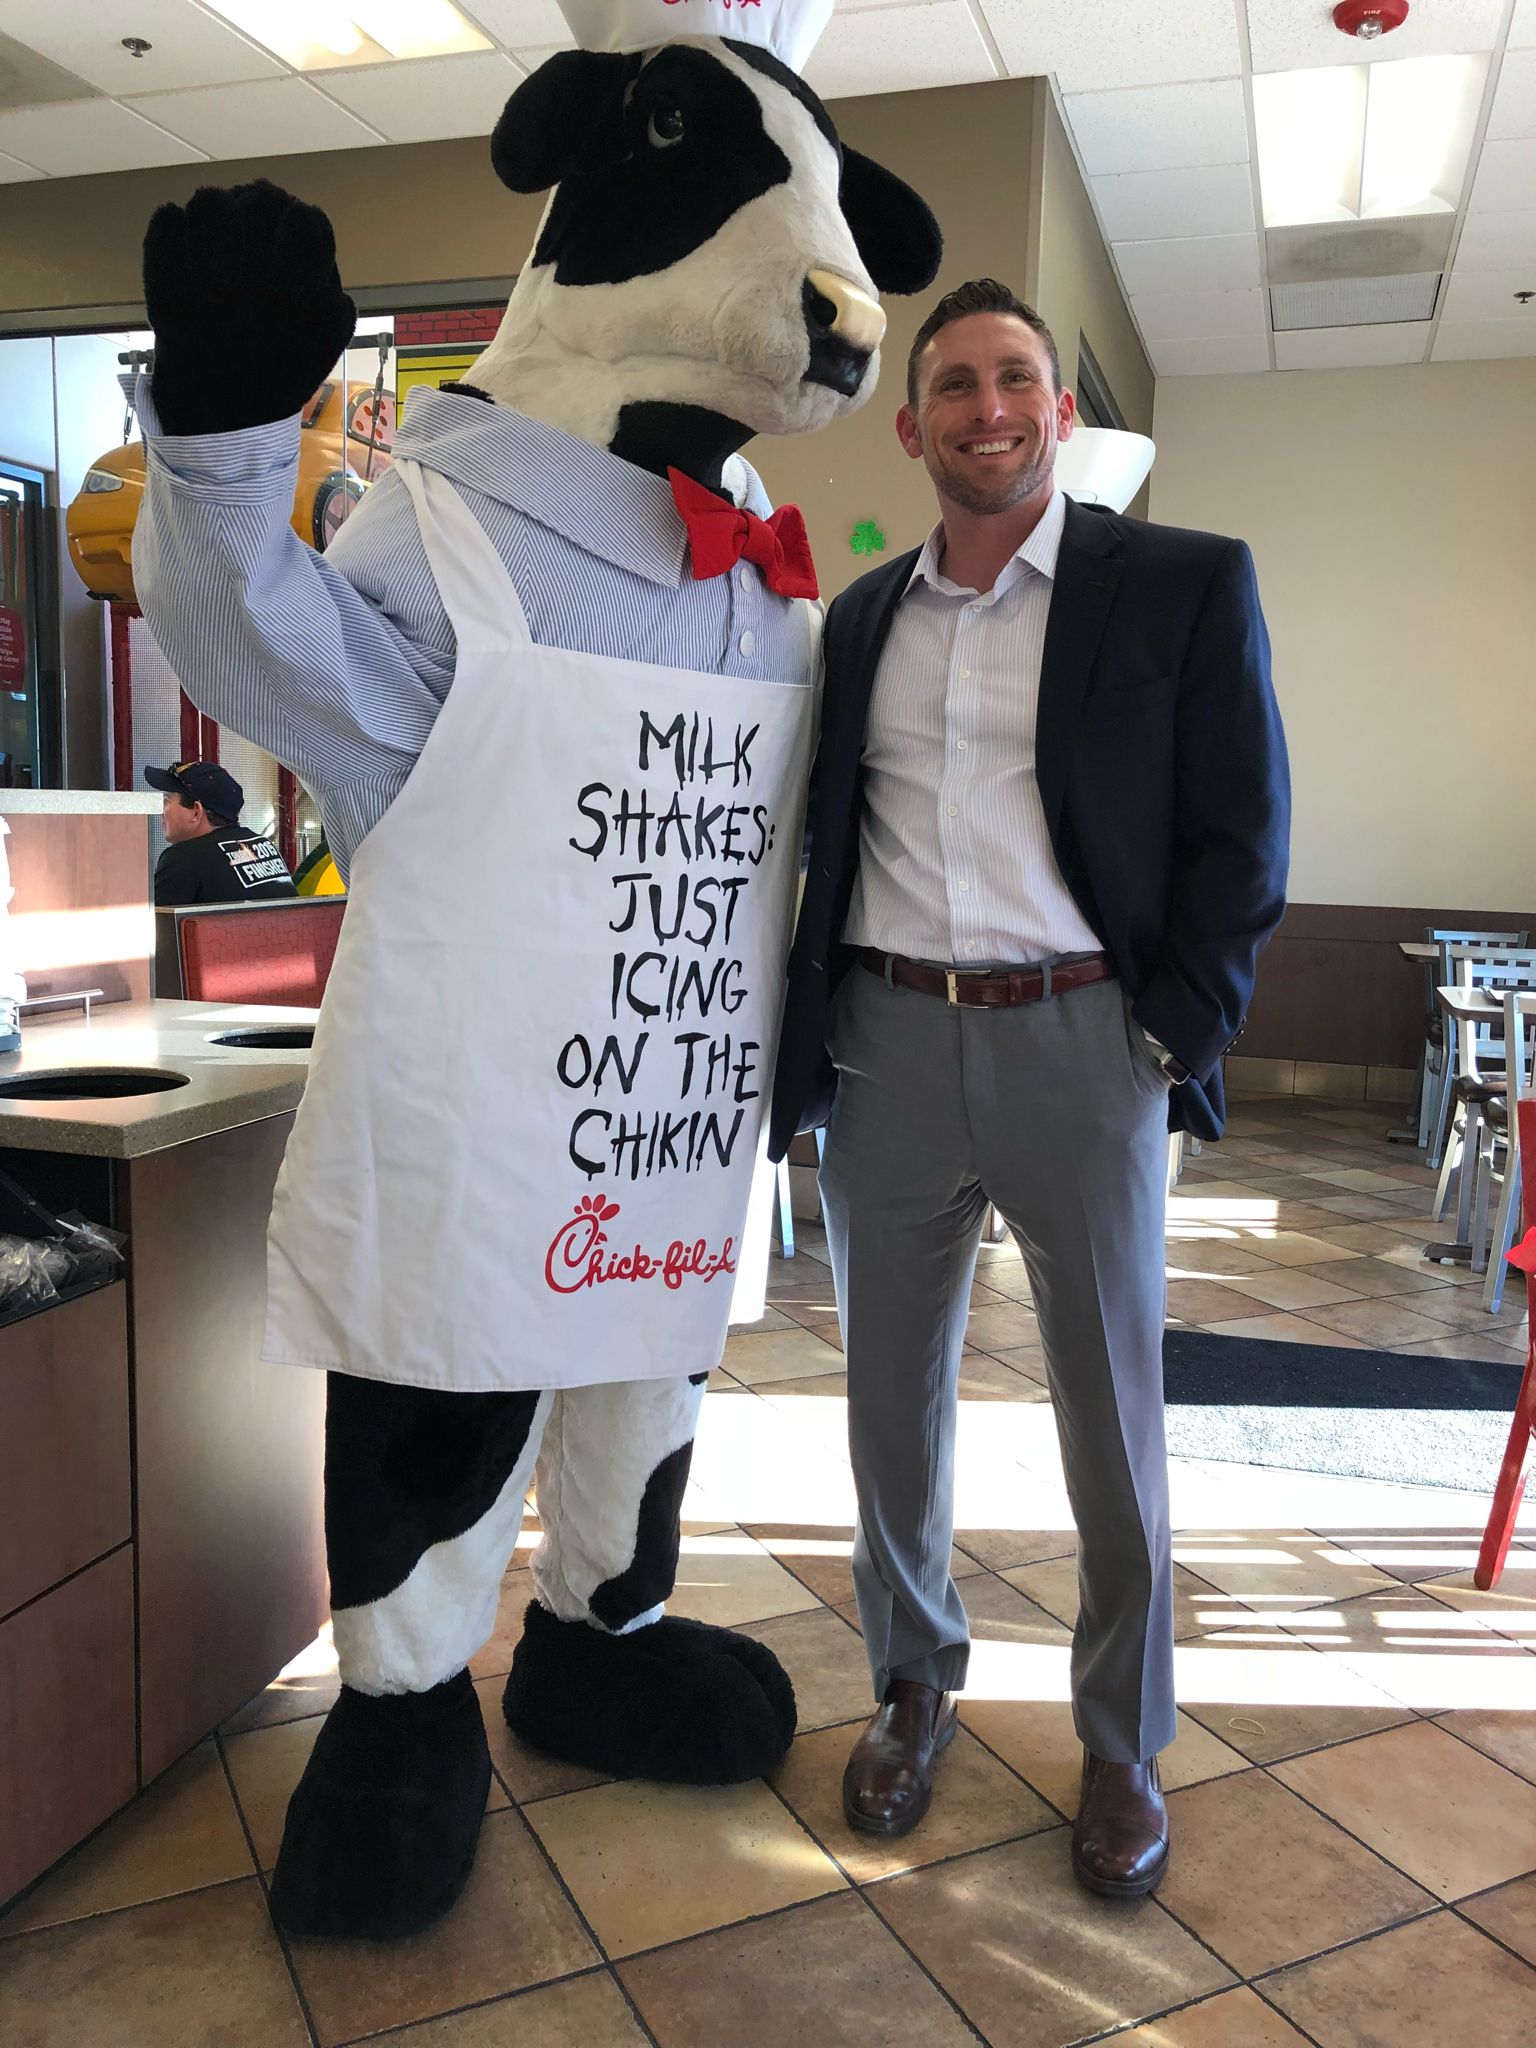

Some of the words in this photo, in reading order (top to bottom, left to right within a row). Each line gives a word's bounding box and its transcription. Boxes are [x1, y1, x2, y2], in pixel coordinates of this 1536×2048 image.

[638, 710, 760, 790] MILK
[251, 840, 278, 859] 2015
[568, 782, 776, 867] SHAKES:
[608, 872, 750, 953] JUST
[611, 951, 749, 1024] ICING
[556, 1032, 650, 1098] ON
[674, 1032, 761, 1104] THE
[569, 1108, 745, 1182] CHIKIN
[544, 1195, 737, 1294] Chick-fil-A
